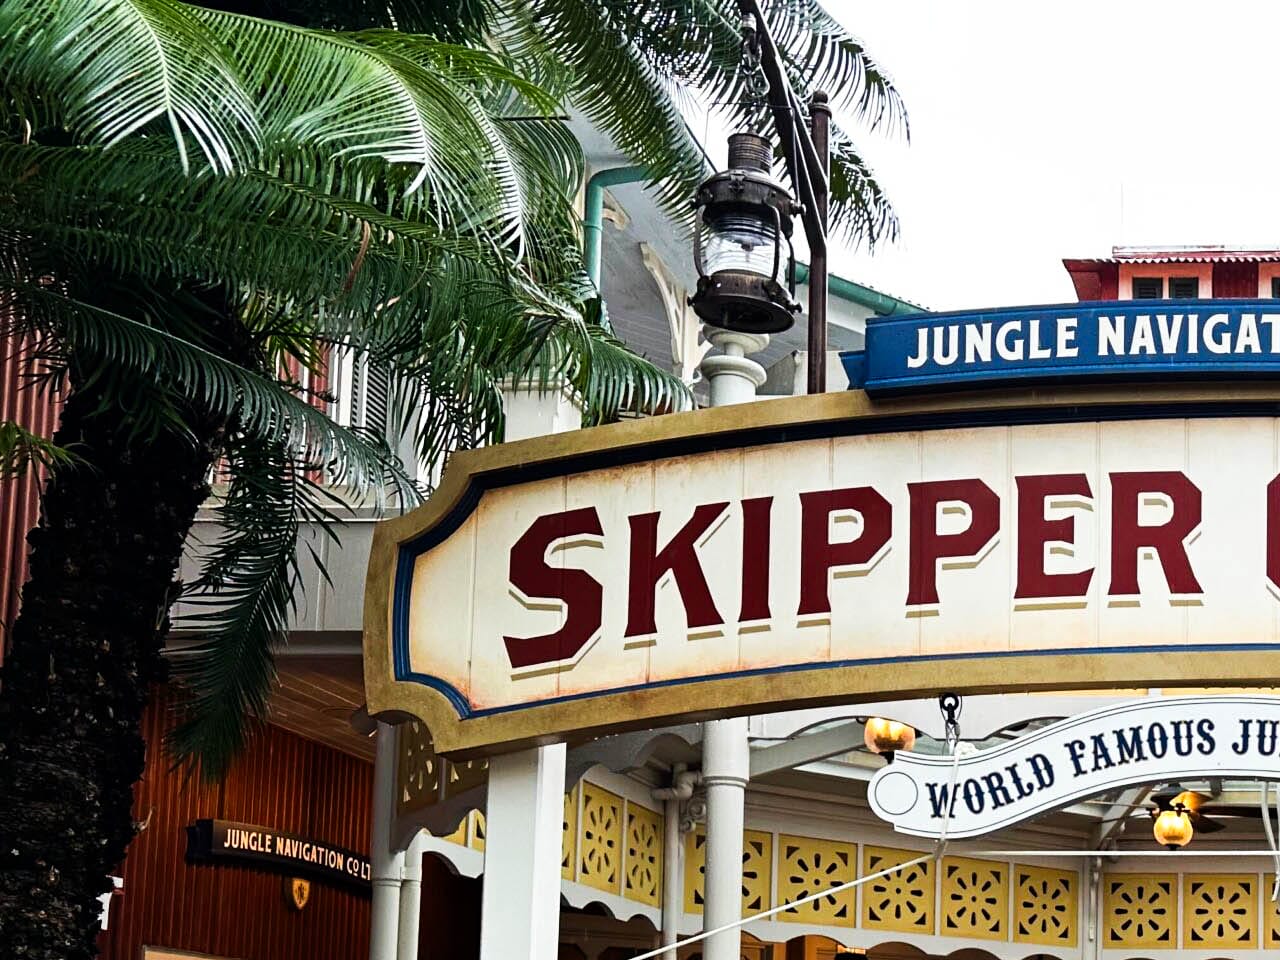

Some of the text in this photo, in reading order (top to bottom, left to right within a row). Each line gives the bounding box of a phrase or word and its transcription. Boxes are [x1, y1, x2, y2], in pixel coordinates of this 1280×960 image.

[907, 320, 1079, 368] JUNGLE
[502, 470, 1203, 669] SKIPPER
[925, 753, 1055, 818] WORLD
[1064, 719, 1216, 777] FAMOUS
[223, 828, 272, 853] JUNGLE
[275, 836, 344, 871] NAVIGATION
[361, 861, 371, 881] LT
